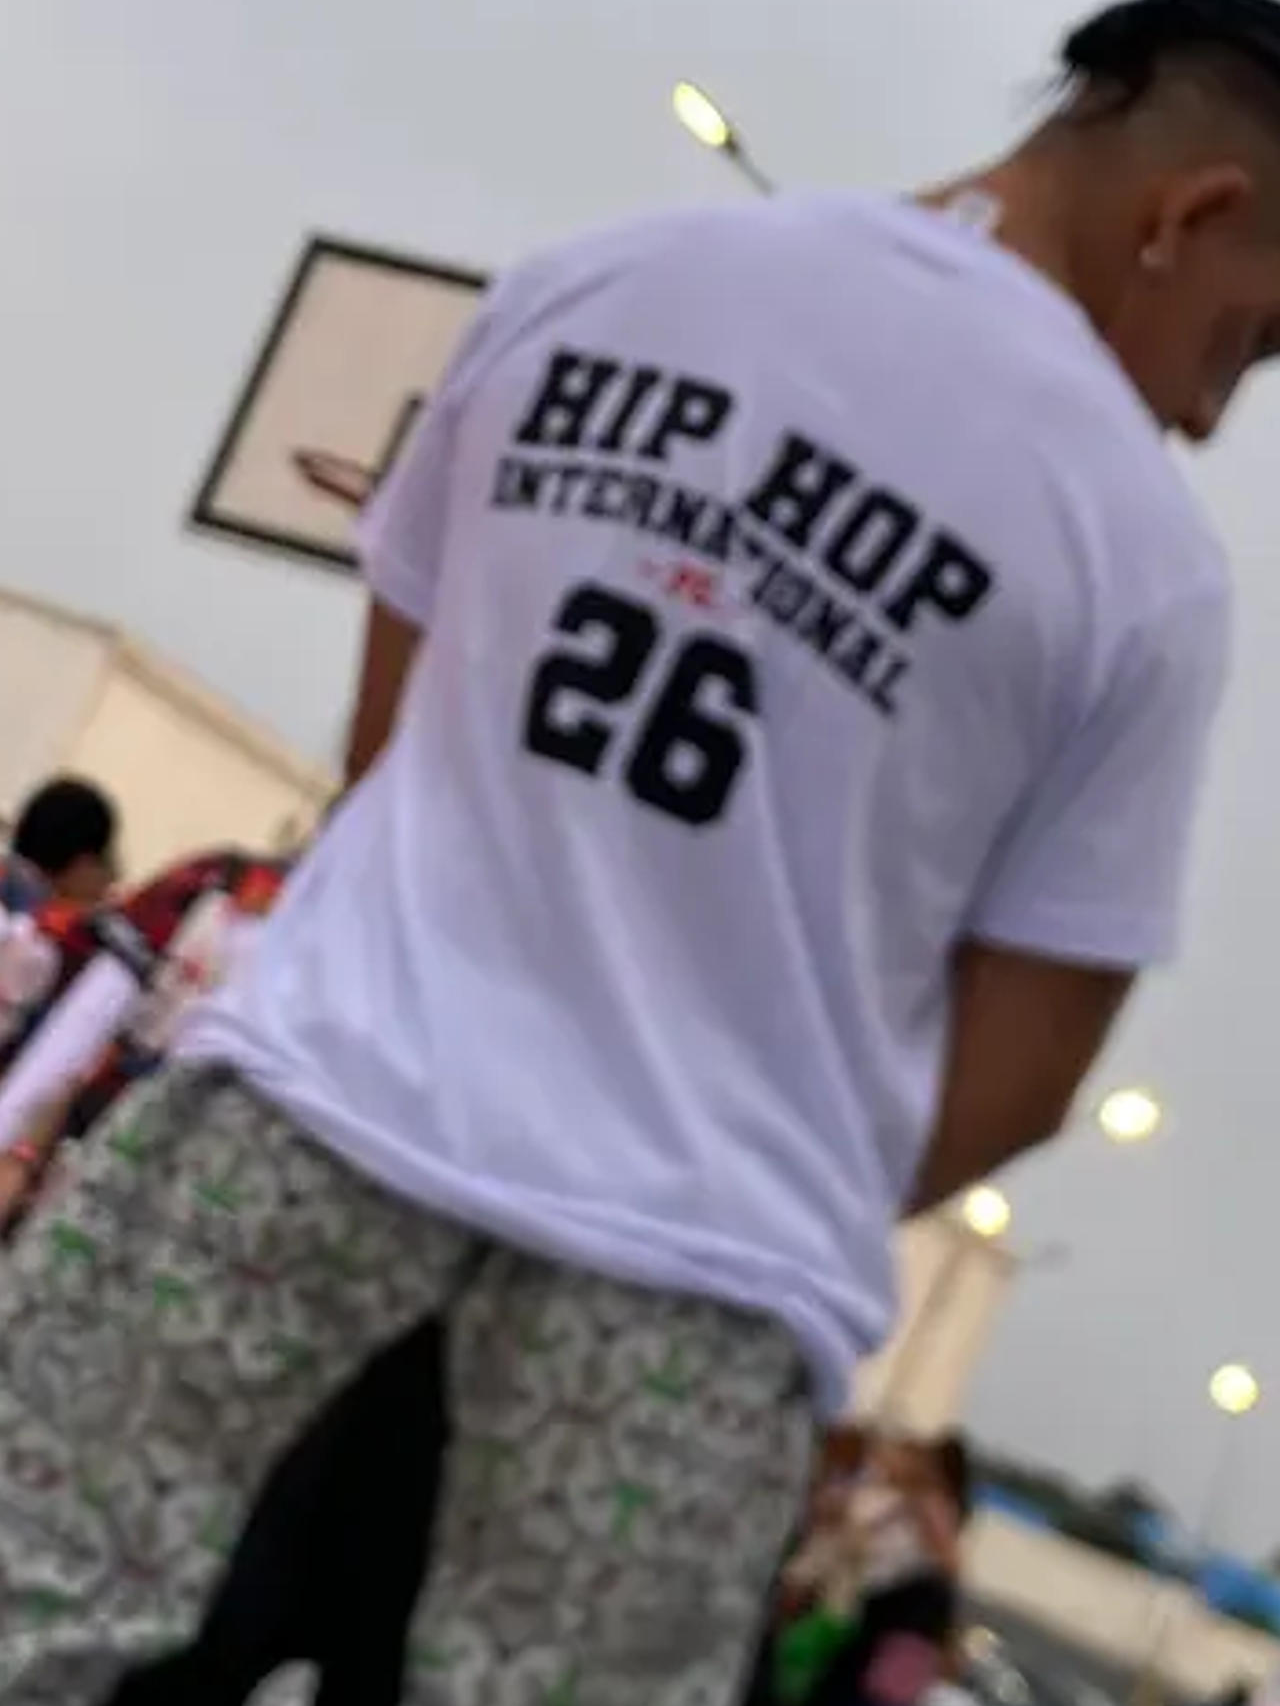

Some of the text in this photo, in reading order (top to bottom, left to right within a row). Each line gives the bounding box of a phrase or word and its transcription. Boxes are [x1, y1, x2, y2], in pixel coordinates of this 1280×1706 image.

[515, 349, 994, 632] HIP HOP
[523, 581, 758, 827] 26
